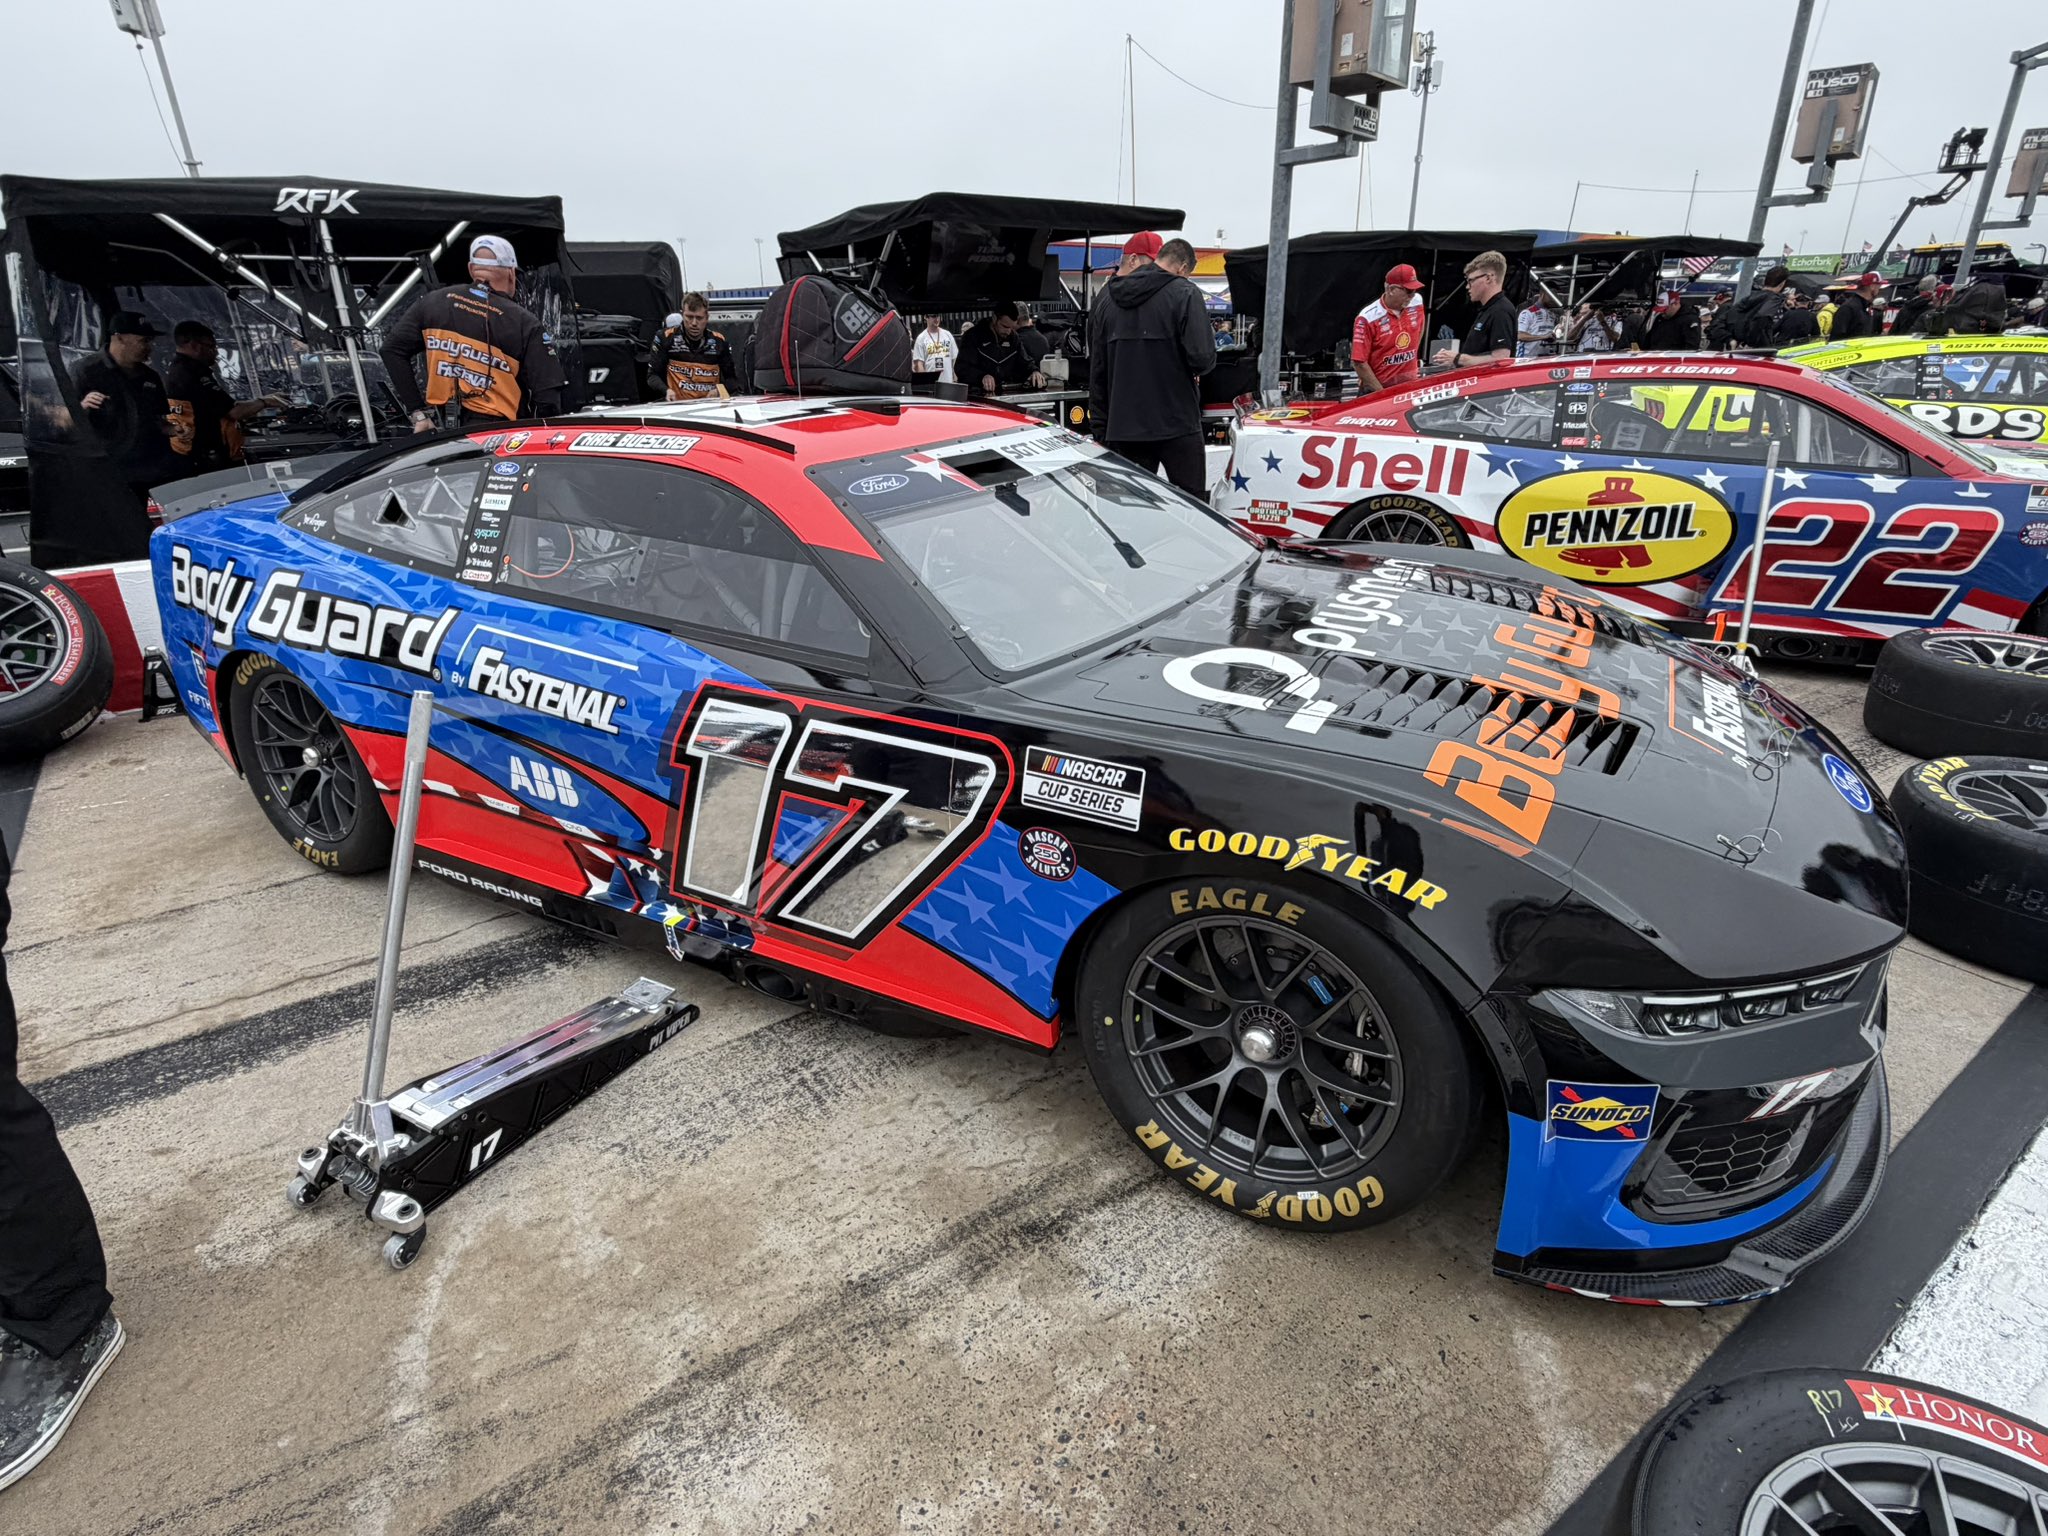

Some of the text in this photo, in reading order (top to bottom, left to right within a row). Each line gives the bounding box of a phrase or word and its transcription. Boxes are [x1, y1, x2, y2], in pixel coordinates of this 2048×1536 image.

[273, 187, 360, 214] RFK
[840, 299, 877, 334] BEL
[588, 367, 610, 383] 17
[1610, 366, 1738, 375] JOEY LOGANO
[1393, 376, 1477, 404] DISCOUNT
[1418, 389, 1454, 403] TIRE
[1335, 416, 1398, 427] Snap-on
[1569, 403, 1587, 414] PPG
[576, 432, 701, 450] CHRIS BUESCHER
[1001, 440, 1034, 460] SGT
[497, 463, 516, 473] Ford
[1298, 435, 1470, 496] Shell
[861, 476, 900, 493] Ford
[1249, 507, 1289, 517] BROTHERS
[1256, 514, 1281, 523] PIZZA
[1523, 502, 1698, 549] PENNZOIL
[474, 528, 500, 540] syspro
[472, 558, 493, 568] Trimble
[479, 545, 498, 554] TULIP
[1713, 497, 2004, 620] 22
[54, 594, 78, 626] HONOR
[55, 637, 83, 682] REMEMBER
[147, 661, 162, 670] 17
[188, 689, 213, 712] FIFTH
[451, 646, 618, 734] By FASTENAL
[511, 755, 579, 808] ABB
[1060, 758, 1127, 787] NASCAR
[1831, 763, 1866, 805] Ford
[1038, 781, 1125, 813] CUP SERIES
[684, 697, 997, 939] 17
[293, 837, 340, 867] EAGLE
[1026, 831, 1069, 852] NASCAR
[1034, 847, 1062, 860] 250
[1026, 855, 1070, 877] SALUTES
[1169, 828, 1448, 911] GOODYEAR
[418, 860, 543, 907] FORD RACING
[1170, 887, 1306, 926] EAGLE
[649, 1011, 692, 1052] PIT VIPER
[1745, 1068, 1837, 1121] 17
[1549, 1103, 1651, 1123] SUNOCO
[469, 1128, 503, 1172] 17
[1136, 1119, 1385, 1222] GOODYEAR
[1897, 1387, 2042, 1456] HONOR
